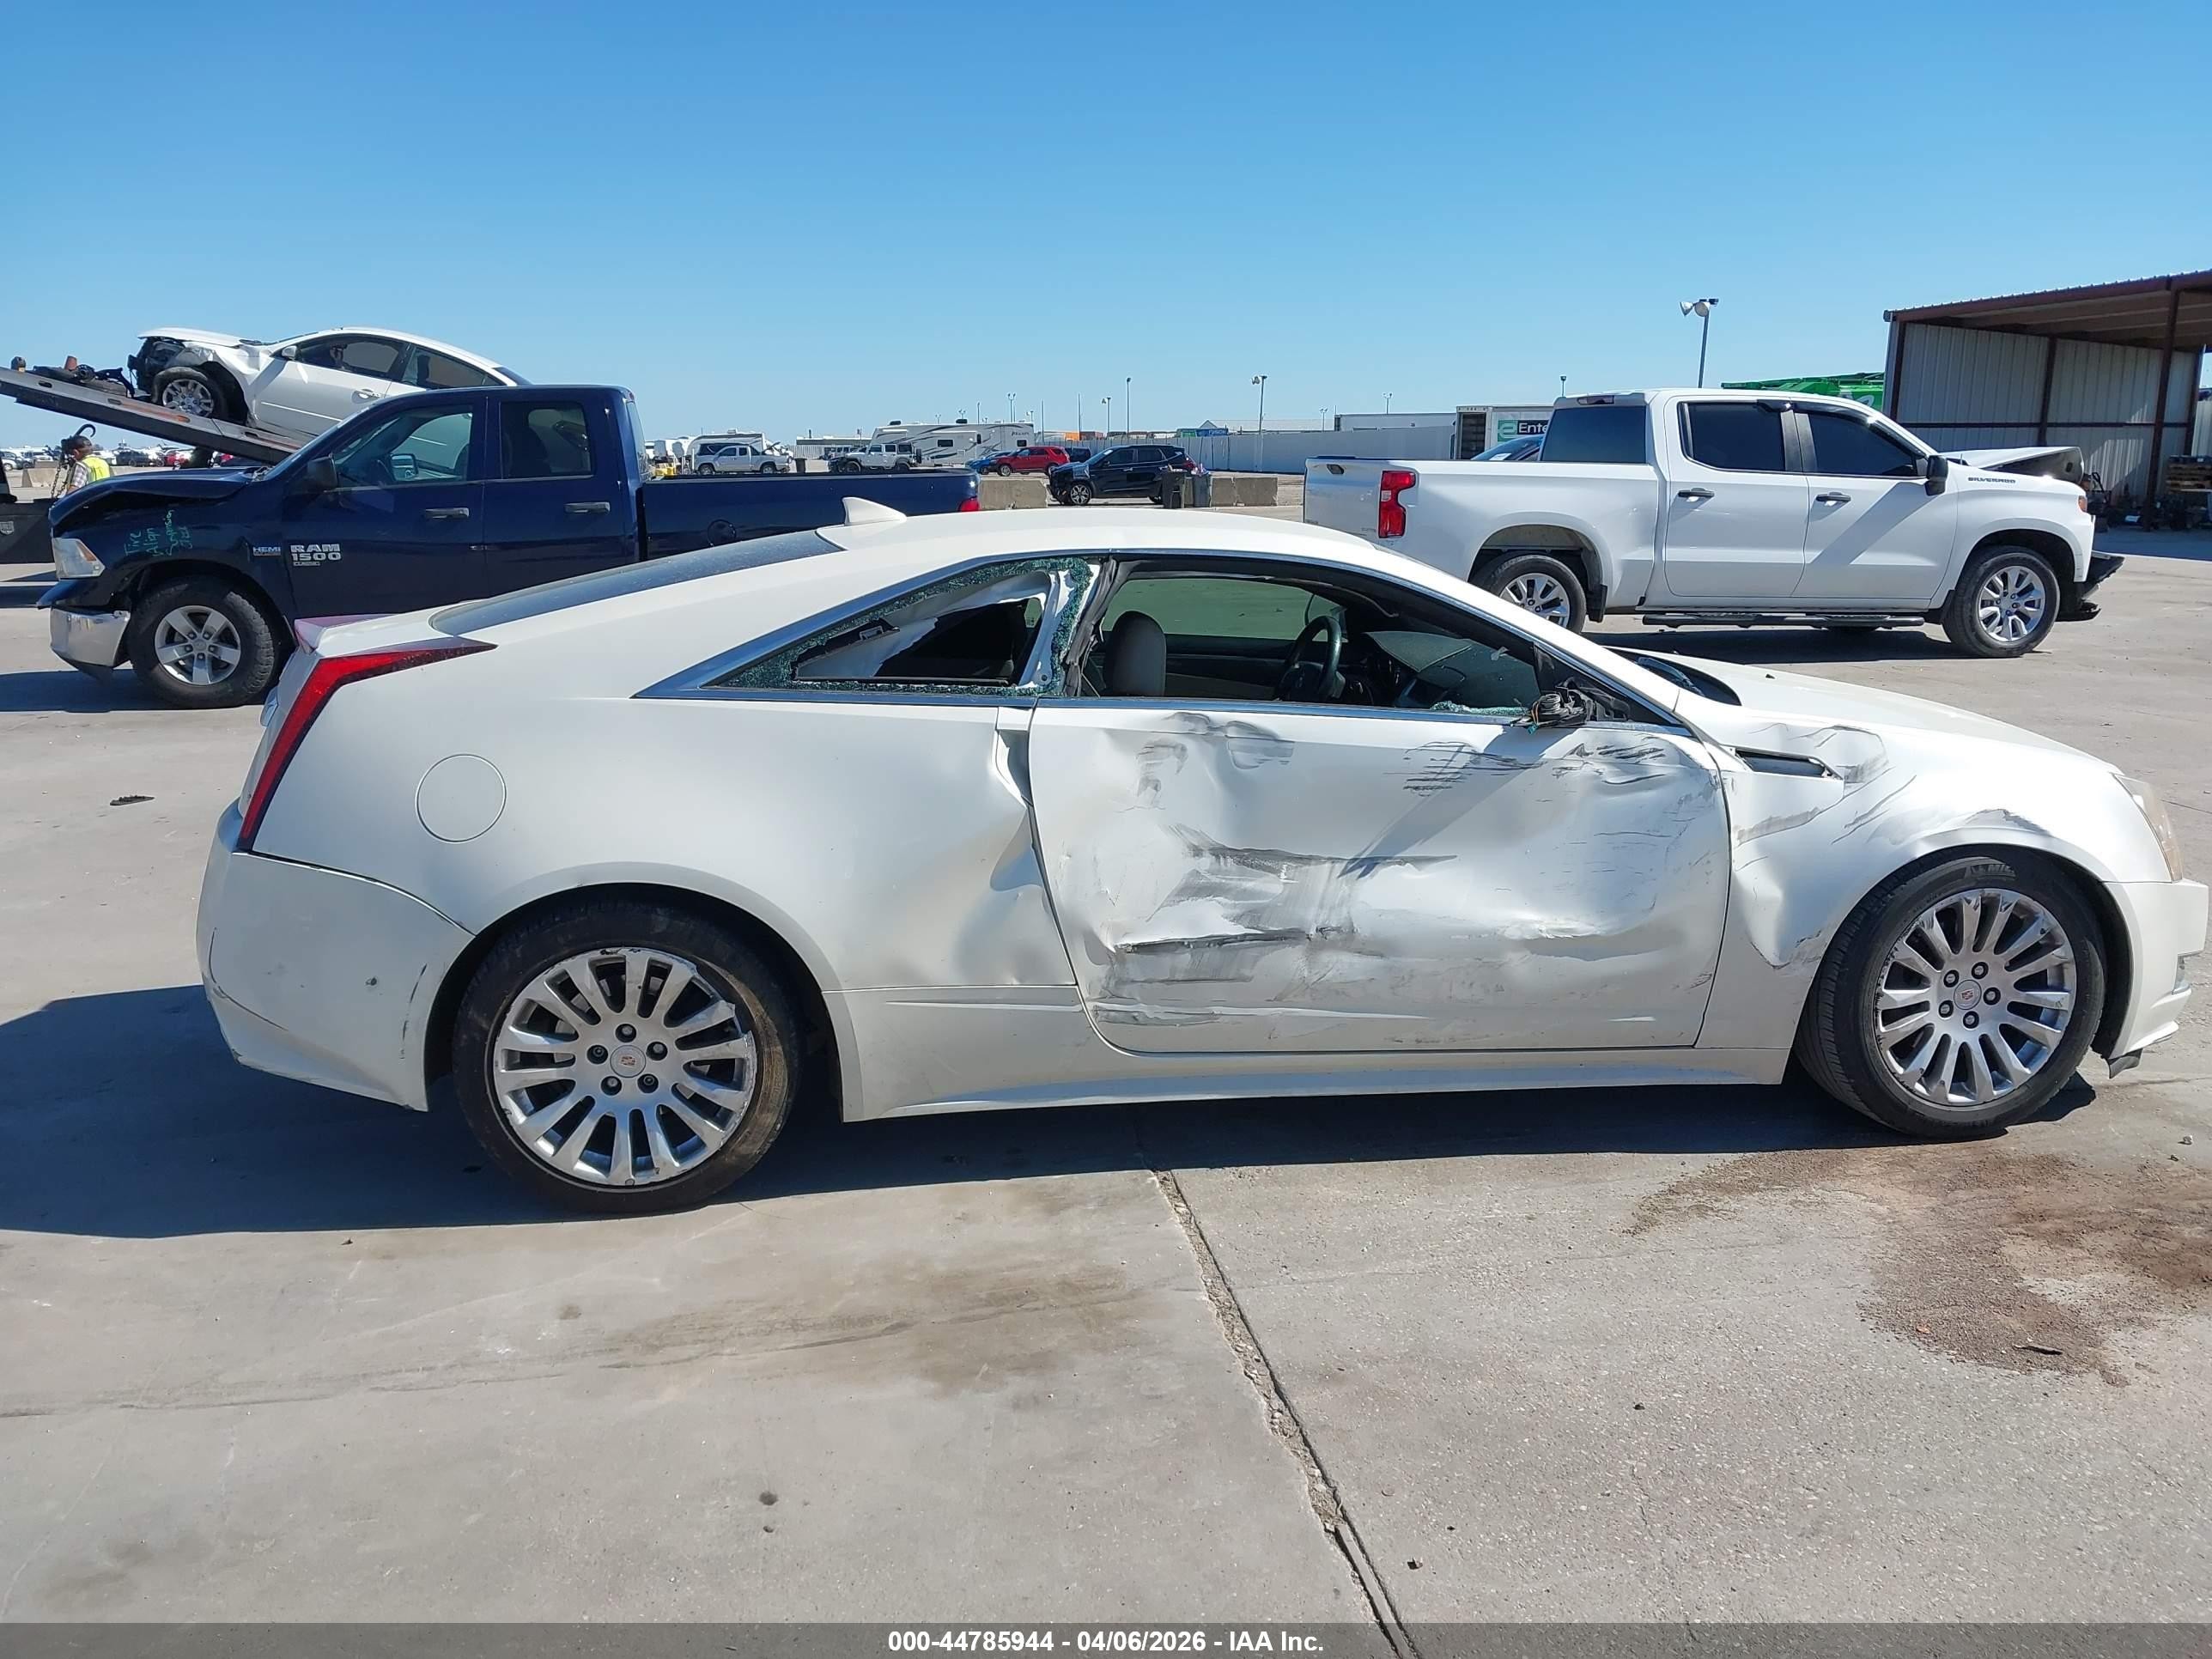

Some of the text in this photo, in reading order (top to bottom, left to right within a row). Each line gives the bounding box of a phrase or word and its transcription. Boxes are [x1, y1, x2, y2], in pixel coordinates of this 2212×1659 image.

[123, 530, 142, 556] Tire
[290, 543, 341, 553] RAM
[291, 552, 342, 562] 1500
